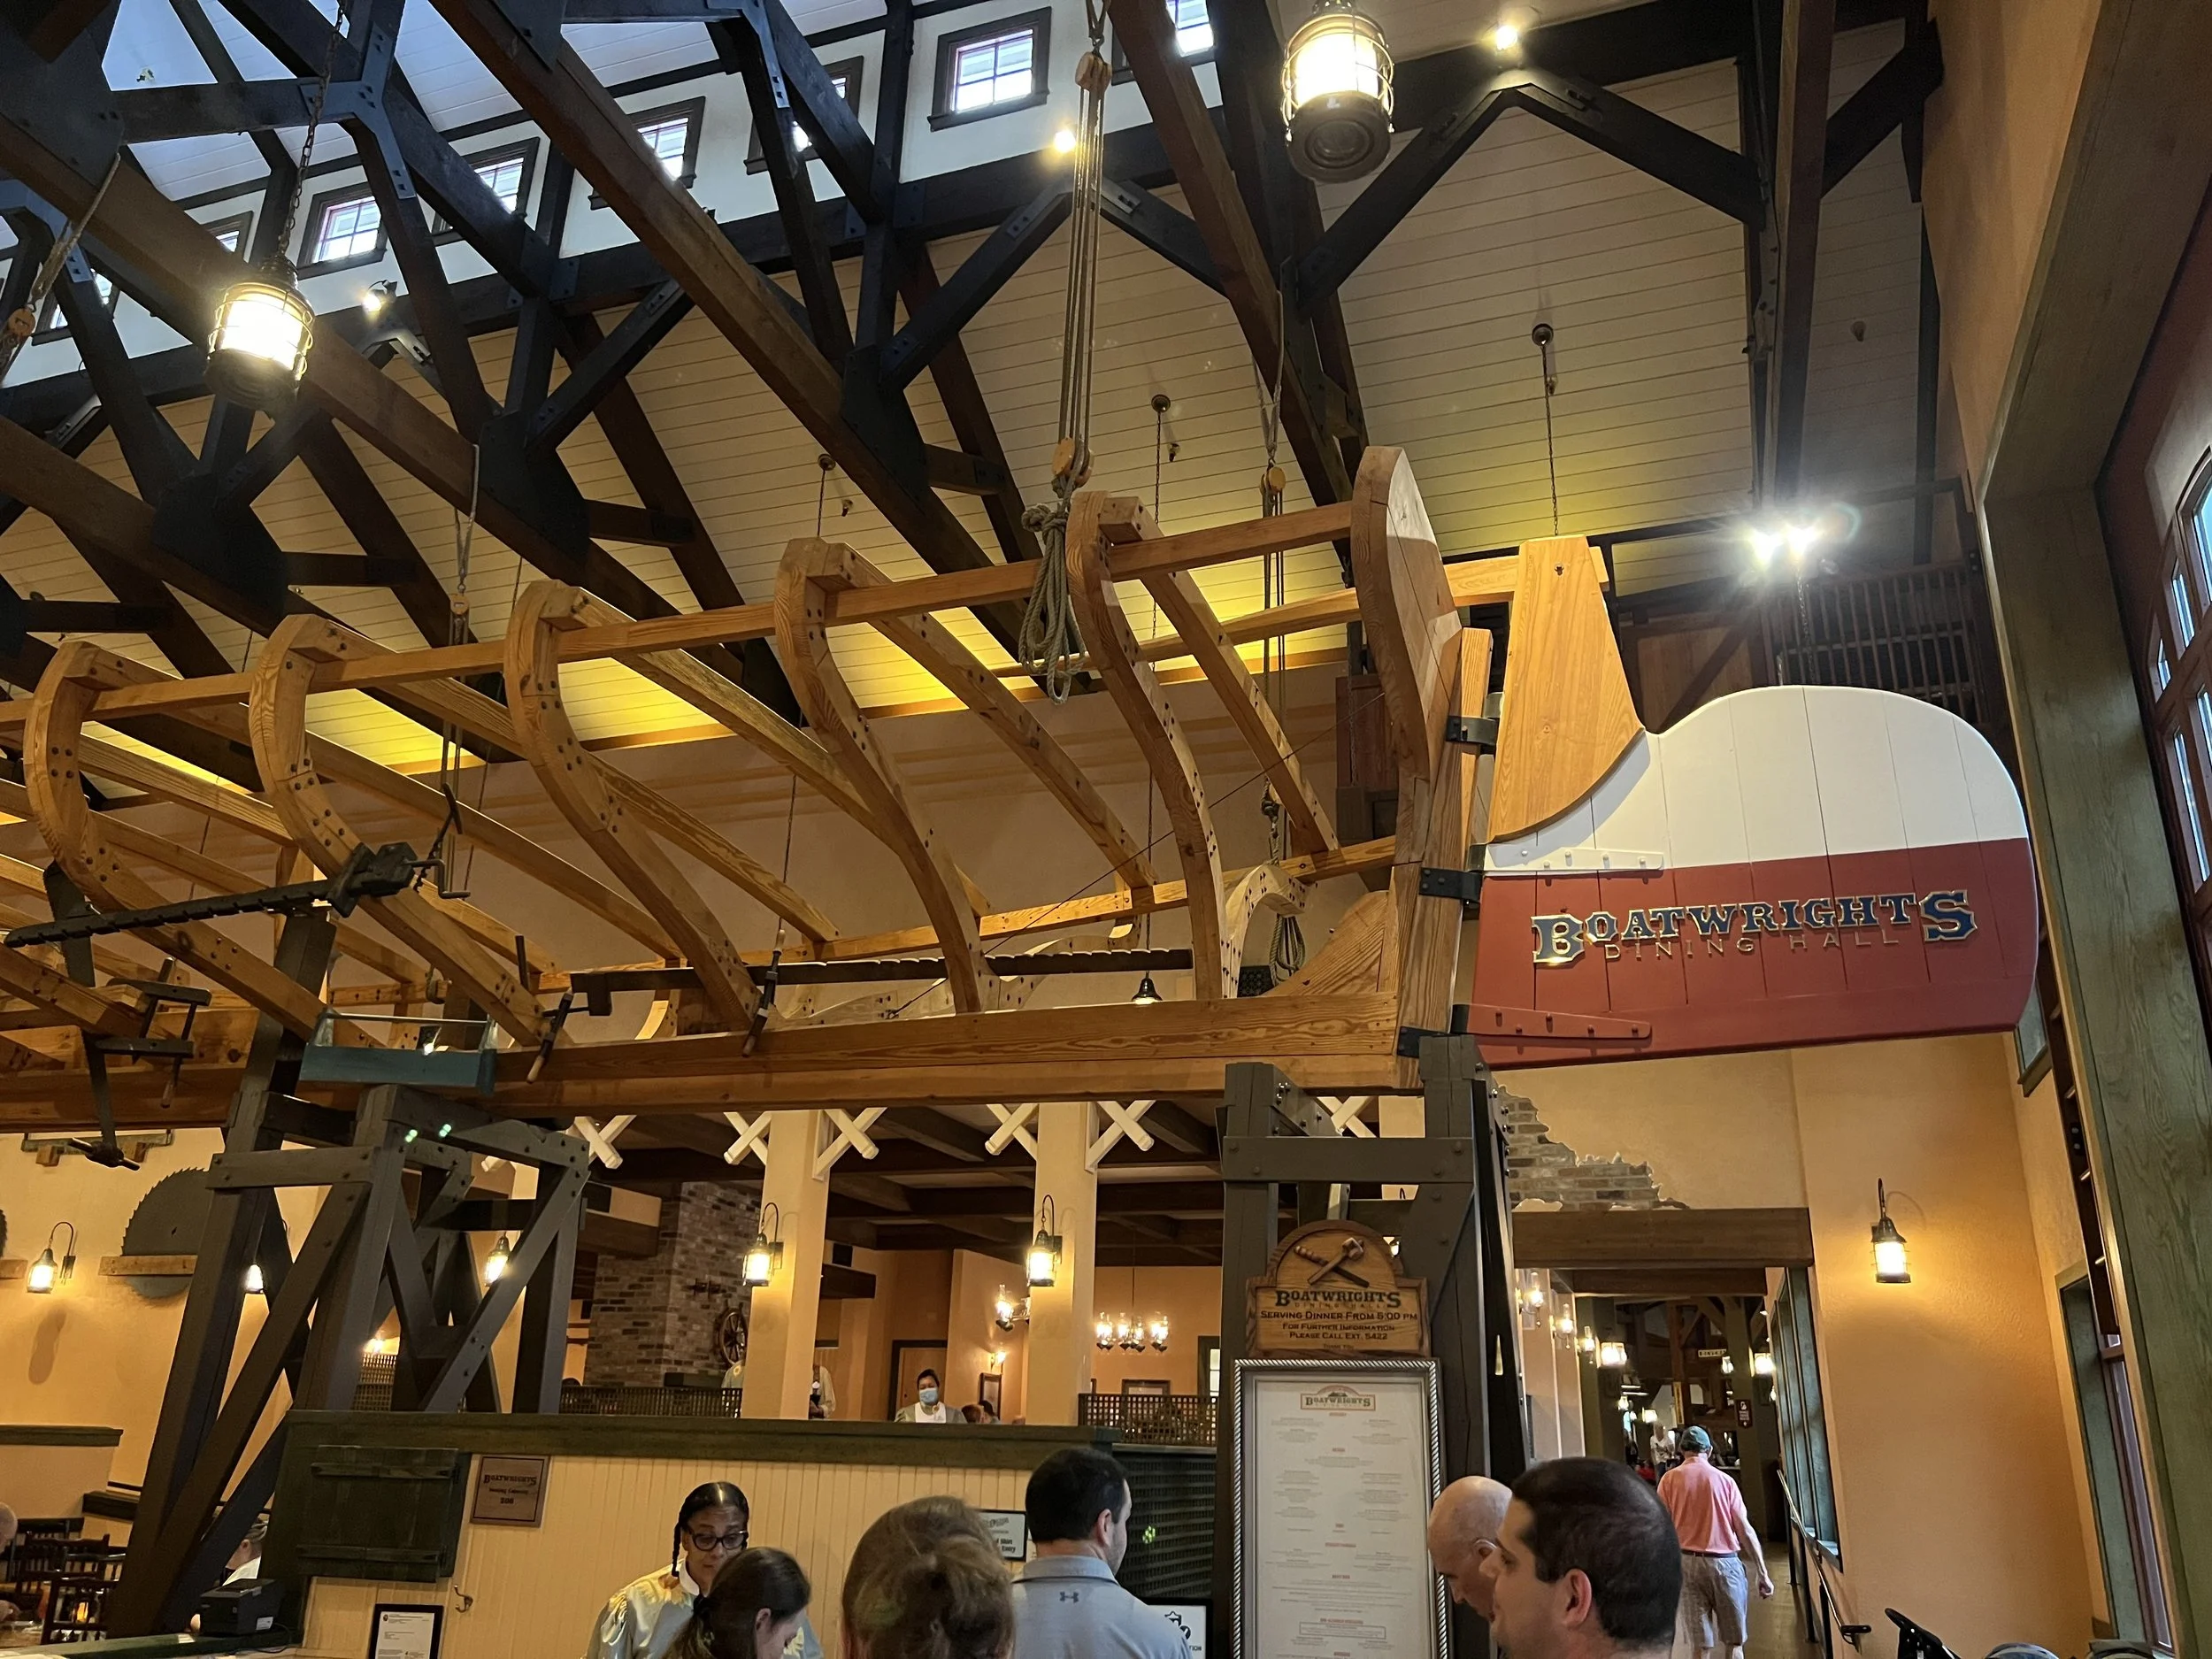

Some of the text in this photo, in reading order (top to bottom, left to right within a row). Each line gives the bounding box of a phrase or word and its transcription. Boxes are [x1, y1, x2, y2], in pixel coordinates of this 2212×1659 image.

[1604, 930, 1899, 960] DINING HALL
[1346, 1311, 1375, 1320] FROM
